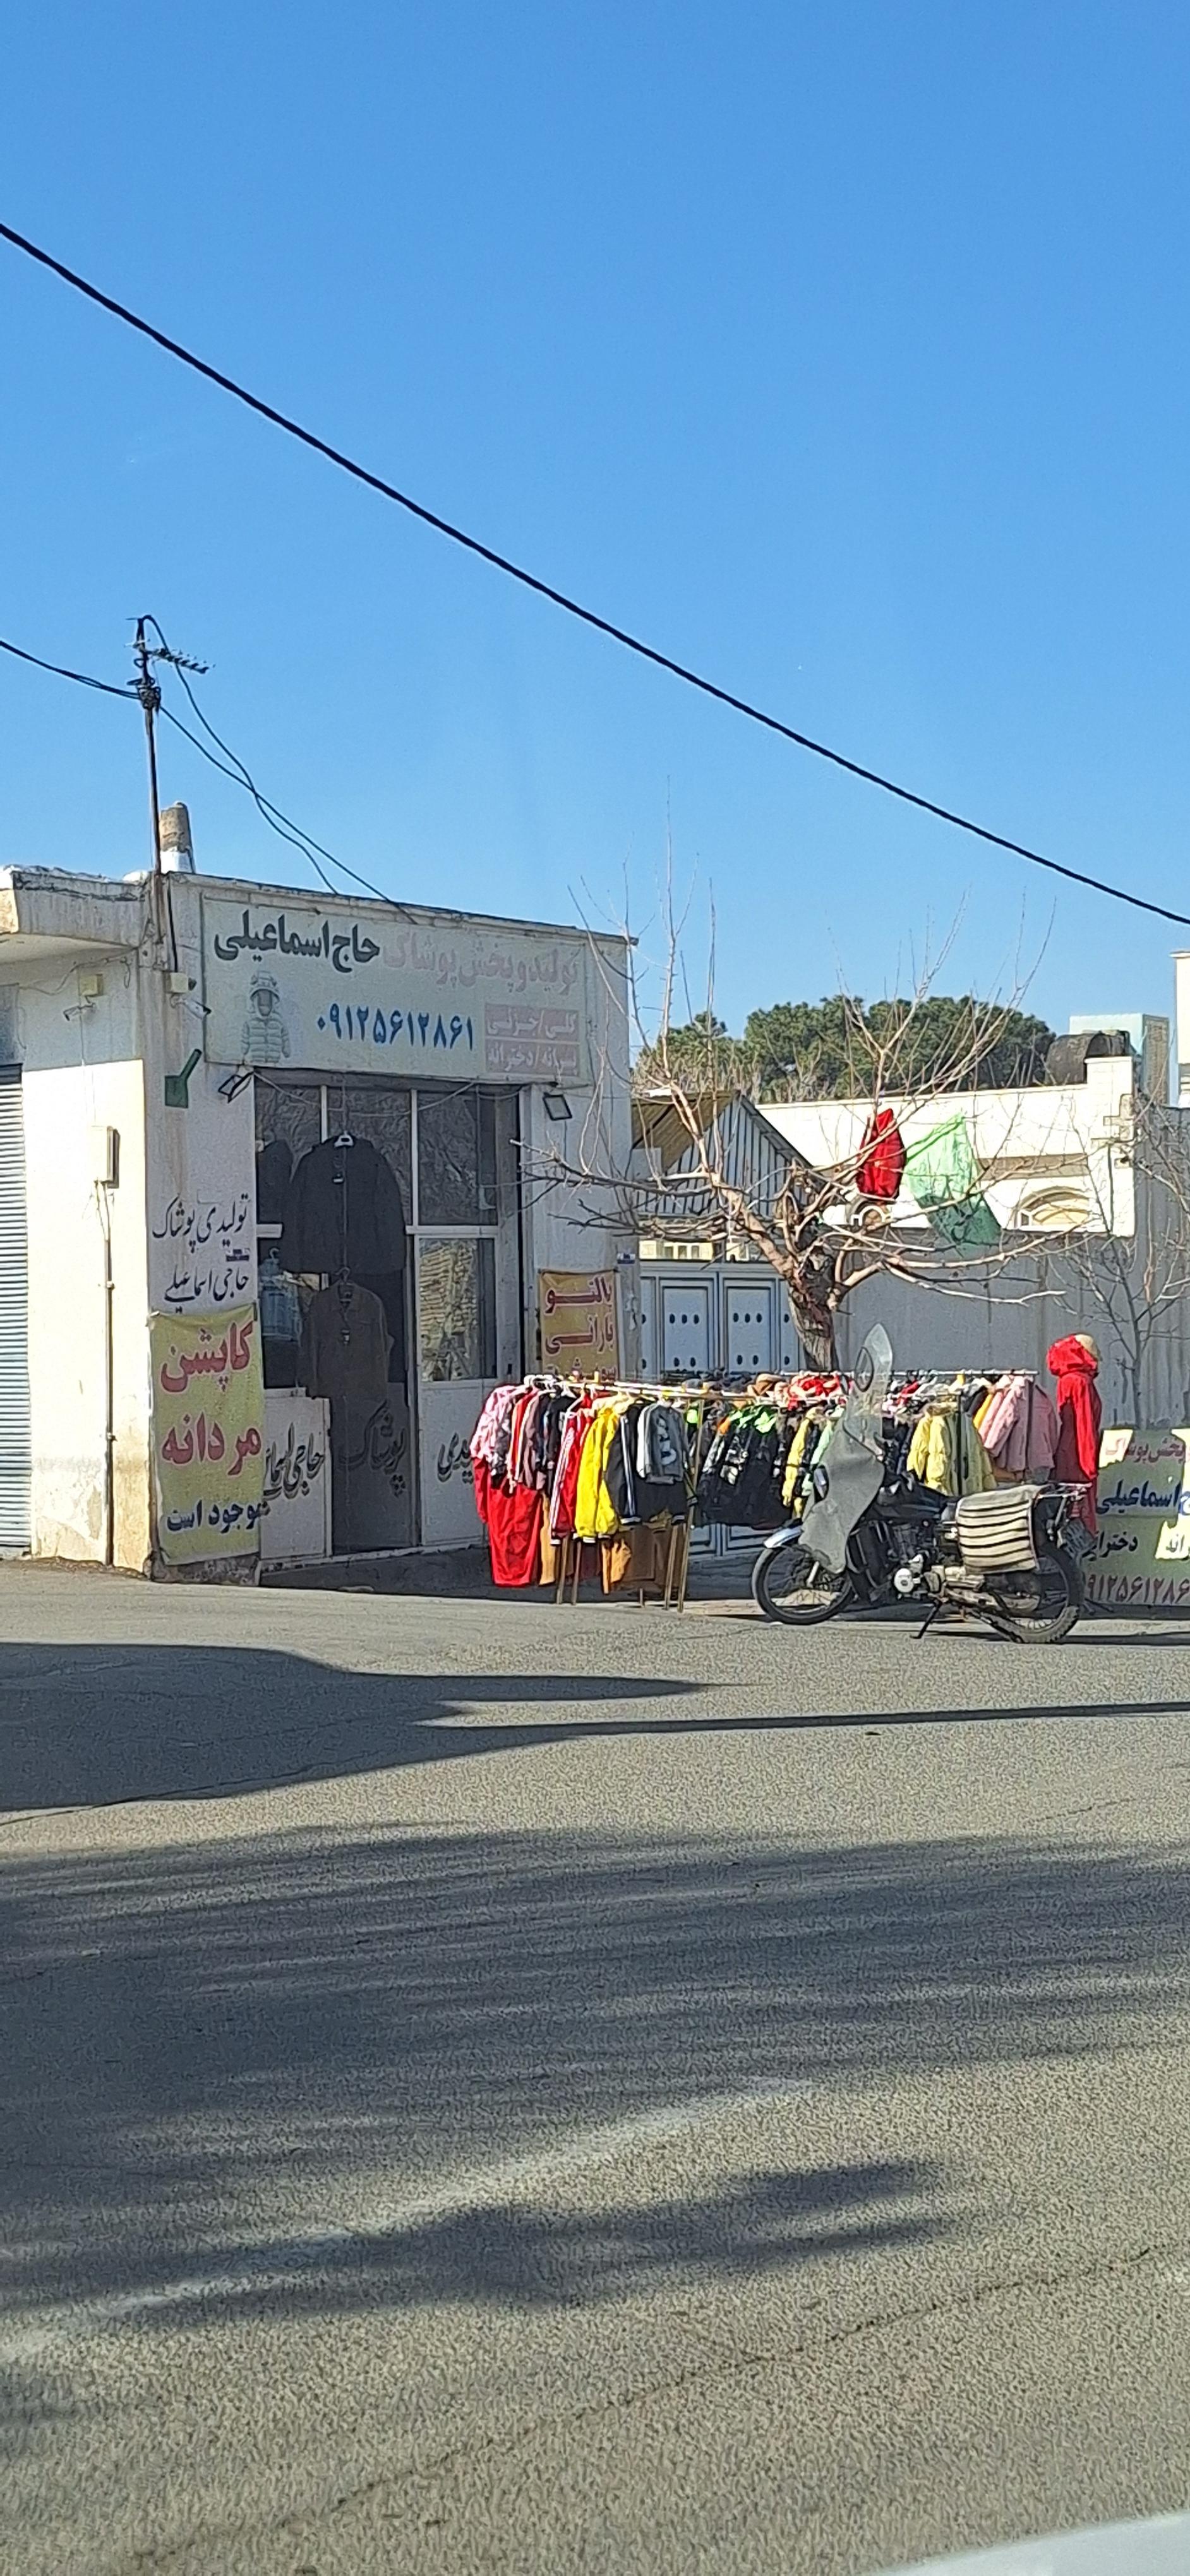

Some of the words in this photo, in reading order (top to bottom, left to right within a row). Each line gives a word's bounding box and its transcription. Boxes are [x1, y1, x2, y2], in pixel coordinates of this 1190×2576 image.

[213, 909, 330, 962] اسماعیلی
[332, 923, 380, 973] حاج
[382, 931, 457, 989] پوشاک
[459, 939, 513, 993] پخش
[515, 960, 527, 993] و
[528, 948, 578, 996] تولید
[316, 1003, 473, 1051] ۰۹۱۲۵۶۱۲۸۶۱
[152, 1192, 196, 1254] پوشاک
[196, 1193, 249, 1248] تولیدی
[164, 1264, 213, 1314] اسماعیلی
[212, 1266, 249, 1301] حاجی
[544, 1276, 613, 1314] پالتو
[160, 1321, 254, 1393] کاپشن
[545, 1315, 614, 1355] بارانی
[161, 1411, 262, 1477] مردانه
[167, 1499, 203, 1532] است
[1095, 1478, 1182, 1515] اسماعیلی
